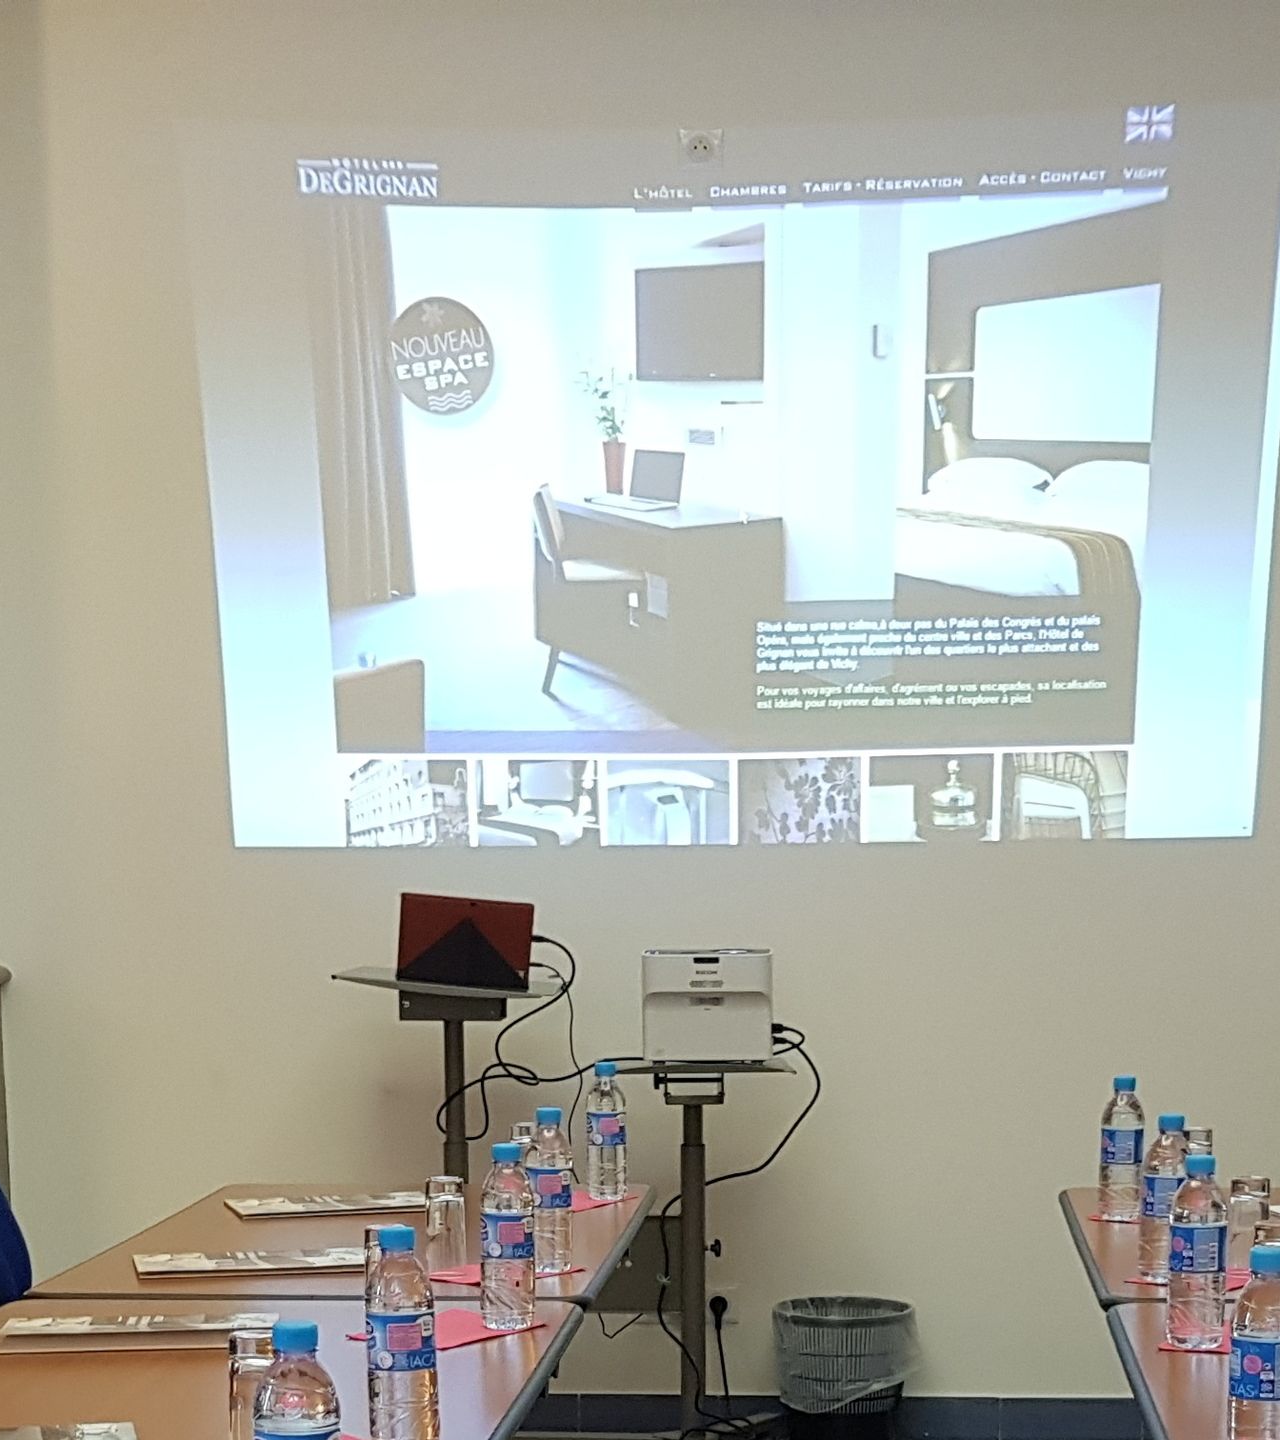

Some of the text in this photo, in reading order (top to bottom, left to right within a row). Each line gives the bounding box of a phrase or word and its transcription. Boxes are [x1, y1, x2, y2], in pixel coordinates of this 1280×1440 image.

[1040, 169, 1106, 184] CONTACT
[802, 176, 963, 193] TARIFS RÉSERVATION
[710, 185, 787, 198] CHAMBRES
[390, 326, 485, 361] NOUVEAU
[396, 351, 489, 380] ESPACE
[423, 371, 469, 391] SPA
[981, 617, 999, 628] des
[1044, 616, 1055, 626] et
[1057, 615, 1070, 626] du
[984, 629, 1002, 640] des
[1071, 628, 1084, 639] de
[1081, 641, 1099, 652] des
[756, 685, 780, 696] Pour
[781, 687, 799, 696] vos
[804, 699, 826, 710] pour
